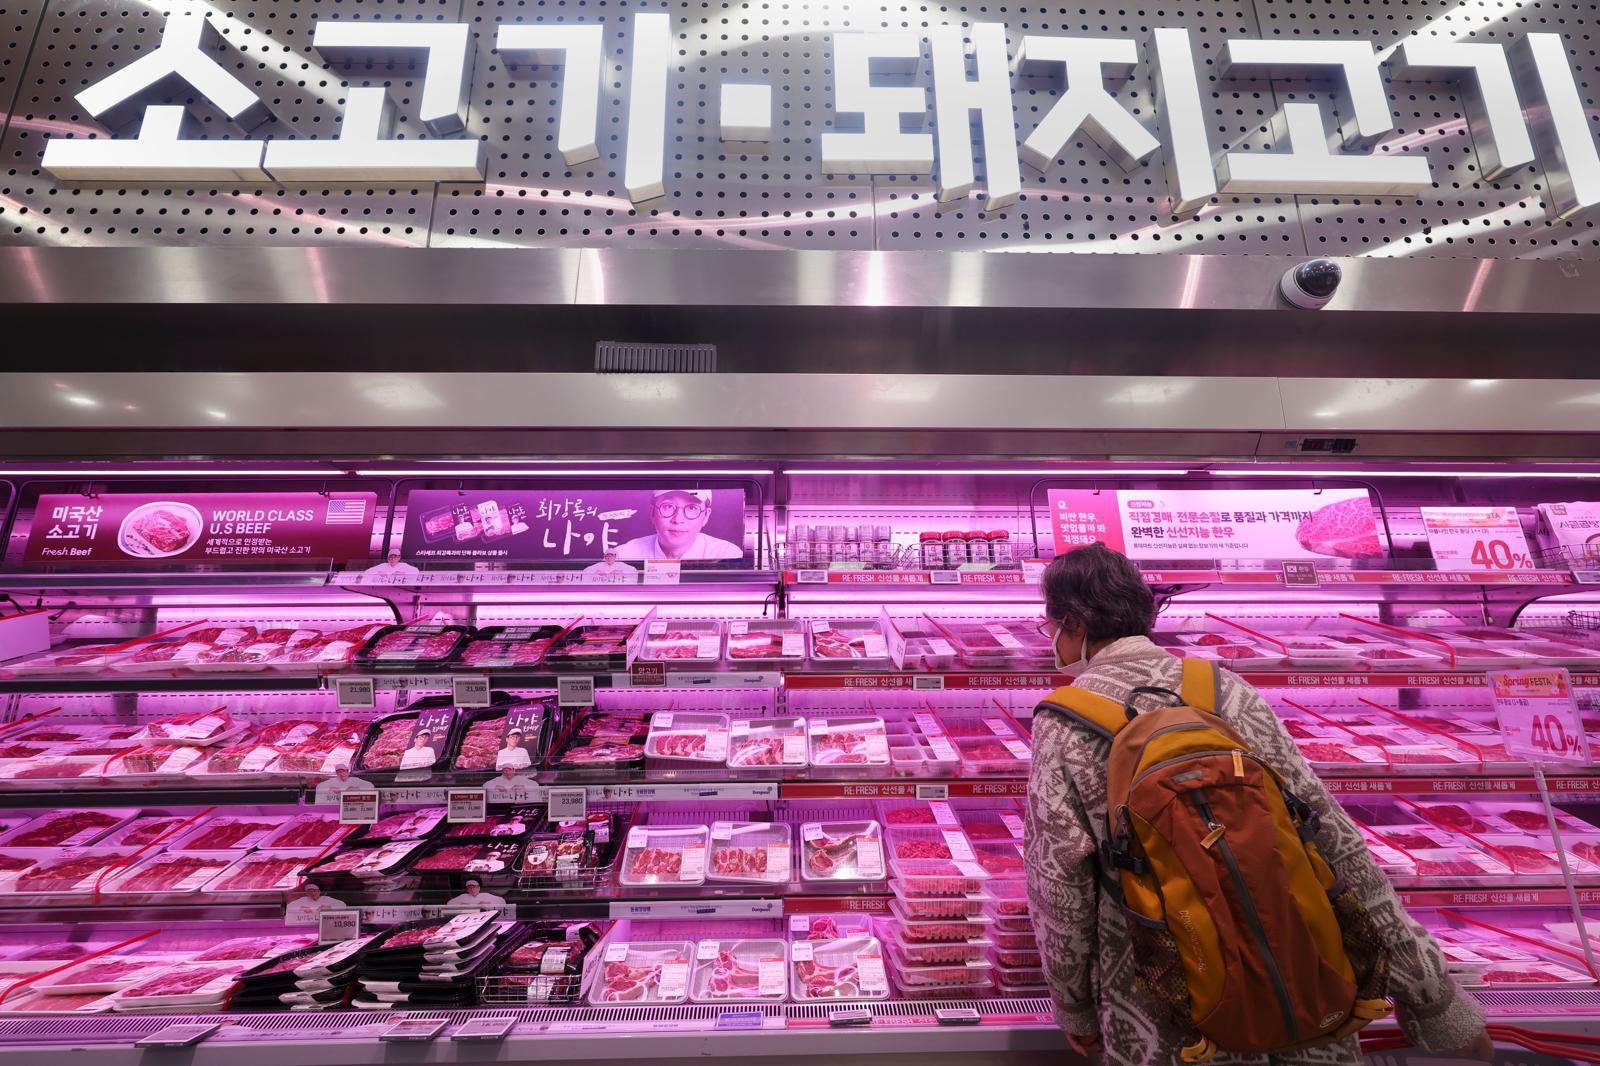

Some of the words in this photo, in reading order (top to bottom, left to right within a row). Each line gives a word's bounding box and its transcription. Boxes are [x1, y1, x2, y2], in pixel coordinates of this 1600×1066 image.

[52, 505, 103, 523] 미국산
[536, 498, 599, 521] 최강록의
[213, 510, 265, 522] WORLD
[267, 510, 314, 522] CLASS
[1059, 512, 1078, 522] 비싼
[1234, 511, 1267, 523] 품질과
[1269, 511, 1313, 523] 가격까지
[45, 523, 98, 540] 소고기
[210, 523, 233, 535] U.S
[235, 523, 272, 534] BEEF
[1131, 526, 1164, 539] 완벽한
[1166, 526, 1210, 539] 신선지능
[1212, 526, 1235, 539] 한우
[207, 538, 242, 546] 세계적으로
[243, 538, 272, 546] 인정받는
[543, 519, 619, 555] 나야
[1063, 534, 1097, 545] 걱정돼요
[41, 547, 68, 556] Fresh
[70, 547, 92, 556] Beef
[205, 546, 233, 554] 부드럽고
[235, 546, 249, 554] 진한
[251, 546, 265, 554] 맛의
[267, 546, 288, 554] 미국산
[289, 546, 311, 554] 소고기
[1471, 539, 1533, 570] 40%
[1503, 674, 1529, 688] Spring
[1530, 678, 1552, 686] FESTA
[1531, 714, 1584, 757] 40%
[562, 797, 583, 805] 23,980
